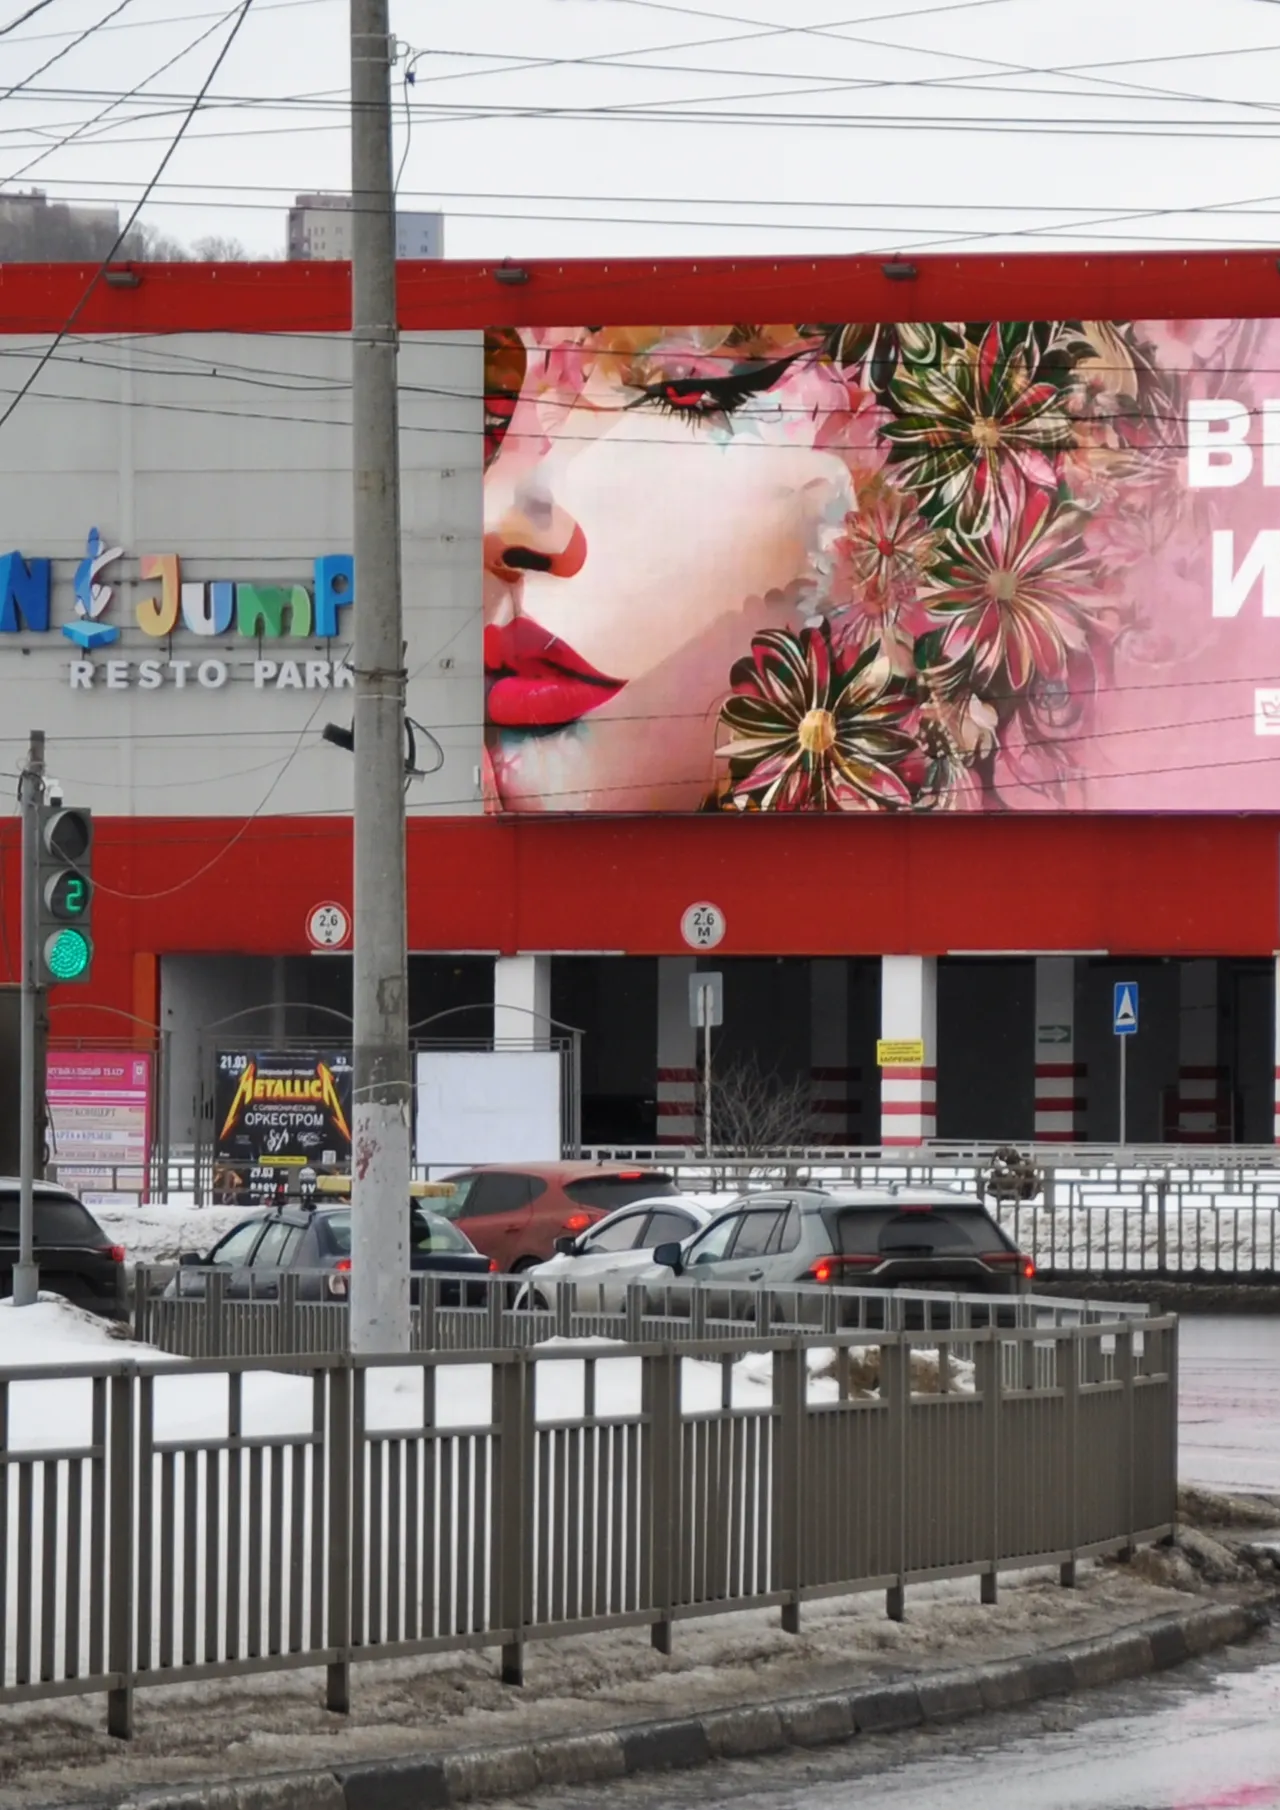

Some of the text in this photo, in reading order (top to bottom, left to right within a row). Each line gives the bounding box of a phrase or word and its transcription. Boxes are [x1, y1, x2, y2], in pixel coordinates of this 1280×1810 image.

[69, 659, 228, 690] RESTO
[66, 879, 82, 911] 2
[220, 1054, 248, 1070] 21.03
[244, 1112, 324, 1127] ОРКЕСТРОМ
